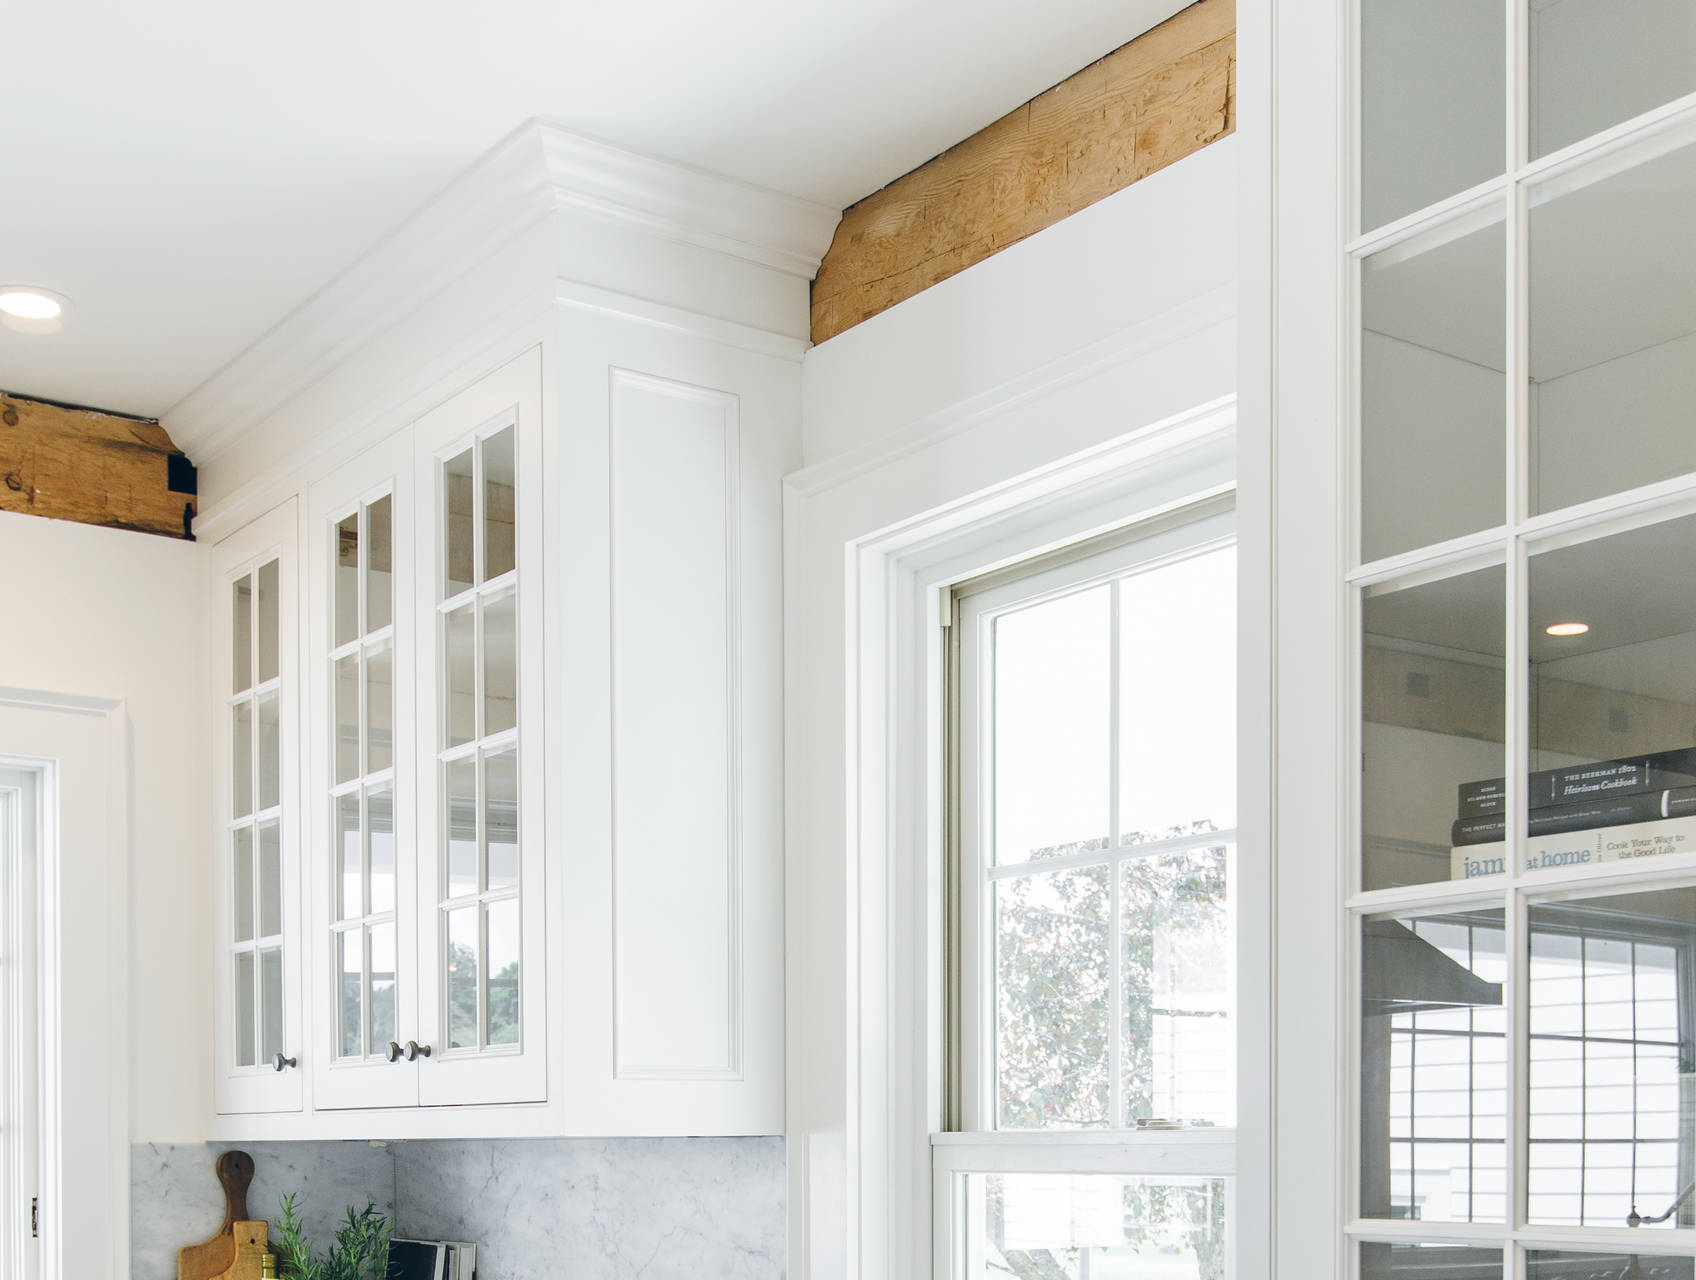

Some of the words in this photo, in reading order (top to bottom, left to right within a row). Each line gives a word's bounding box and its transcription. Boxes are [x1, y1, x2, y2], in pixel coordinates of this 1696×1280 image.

[1564, 774, 1579, 782] THE
[1564, 783, 1601, 795] Heirloom
[1600, 776, 1638, 790] Cookbook
[1607, 842, 1628, 851] Cook
[1631, 839, 1652, 848] Your
[1654, 835, 1674, 846] Way
[1674, 834, 1685, 843] to
[1618, 851, 1632, 860] the
[1633, 847, 1658, 857] Good
[1658, 846, 1677, 855] Life
[1464, 857, 1505, 879] jam
[1540, 849, 1591, 868] home
